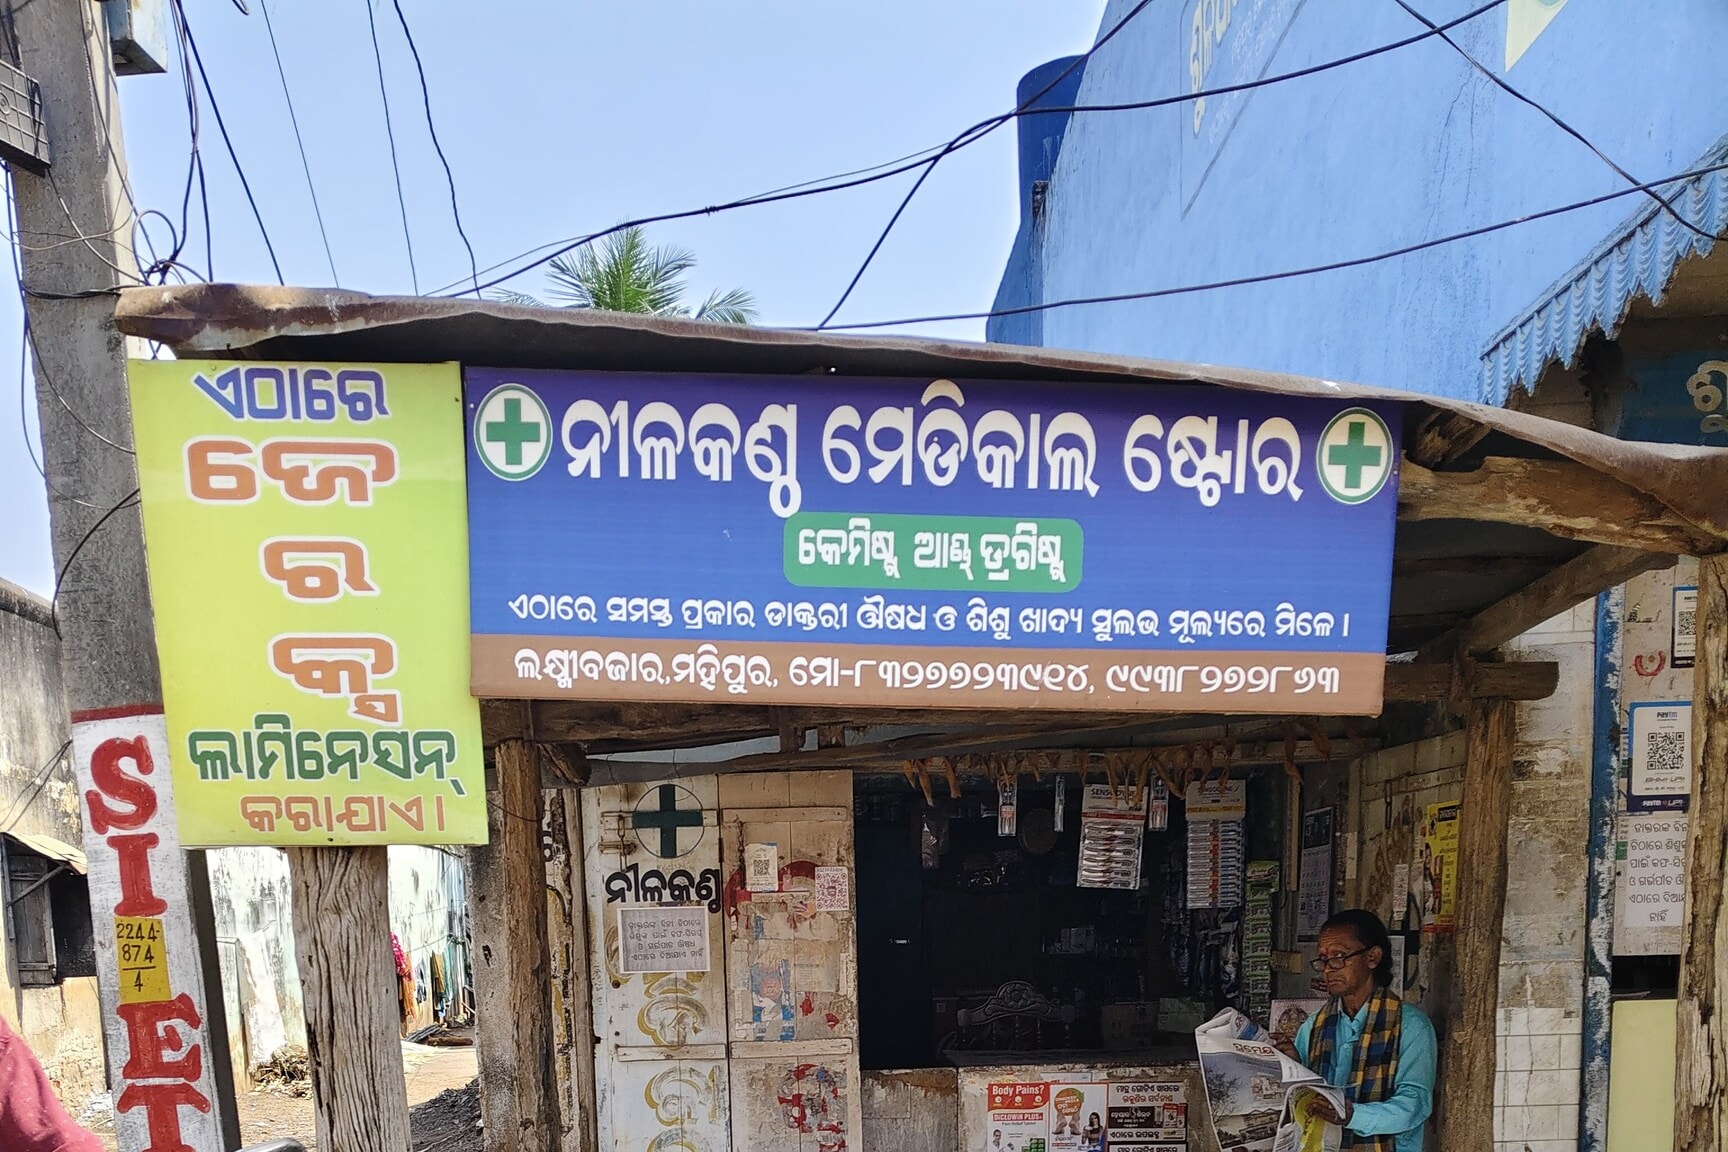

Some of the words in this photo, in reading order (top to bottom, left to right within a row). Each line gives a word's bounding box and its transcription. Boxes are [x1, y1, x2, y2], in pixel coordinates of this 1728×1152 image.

[193, 367, 390, 420] ଏଠାରେ
[561, 398, 801, 518] ନୀଳକଣ୍ଠ
[822, 379, 1100, 497] ମେଡିକାଲ
[1124, 414, 1303, 507] ଷ୍ଟୋର
[508, 594, 598, 623] ଏଠାରେ
[606, 597, 673, 627] ସମସ୍ତ
[681, 598, 755, 630] ପ୍ରକାର
[764, 601, 848, 631] ଡାକ୍ତରୀ
[856, 594, 926, 630] ଔଷଧ
[934, 604, 958, 631] ଓ
[966, 597, 1011, 640] ଶିଶୁ
[1018, 607, 1083, 633] ଖାଦ୍ୟ
[1091, 609, 1160, 641] ସୁଲଭ
[1169, 610, 1267, 644] ମୂଲ୍ୟରେ
[1105, 664, 1341, 694] ୯୯୩୮୨୭୨୮୬୩
[122, 944, 155, 963] 874
[134, 970, 143, 992] 4
[993, 1086, 1013, 1096] Body
[1016, 1085, 1044, 1095] Pains?
